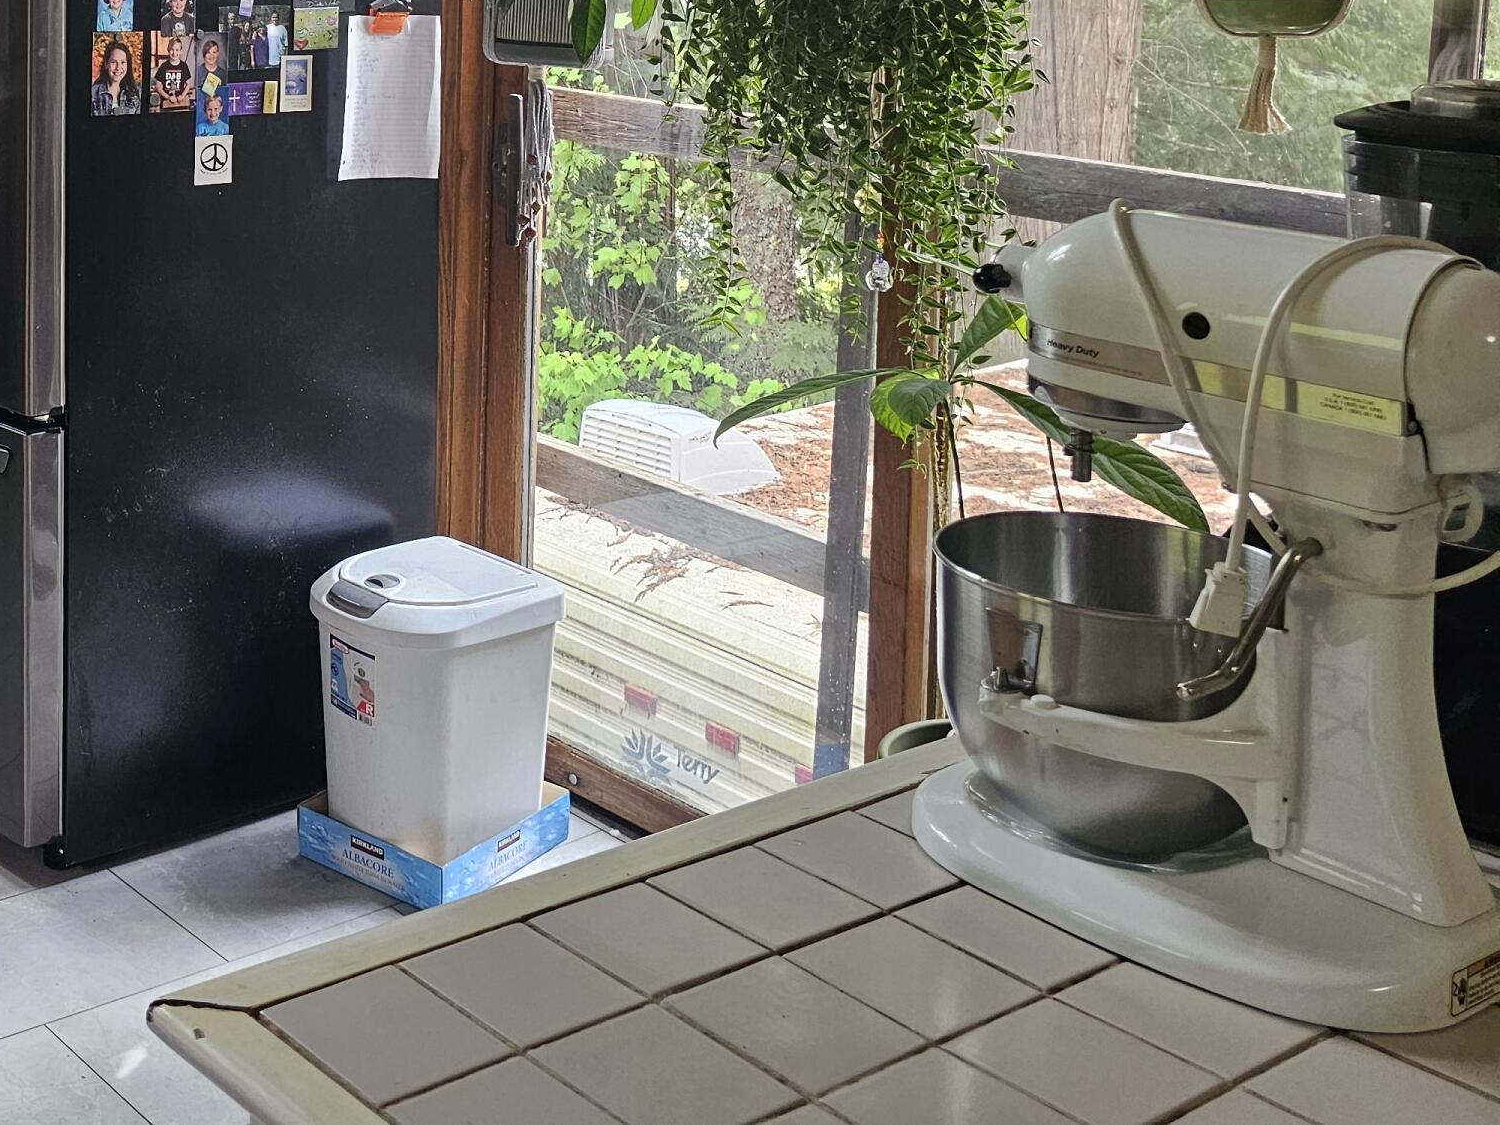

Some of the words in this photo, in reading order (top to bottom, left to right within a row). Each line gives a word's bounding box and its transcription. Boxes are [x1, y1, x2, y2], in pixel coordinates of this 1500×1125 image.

[165, 72, 182, 80] DAB
[165, 80, 181, 89] CT
[1046, 338, 1075, 354] Heavy
[1075, 345, 1100, 359] Duty
[673, 743, 720, 785] Terry
[342, 848, 395, 879] ALBACORE
